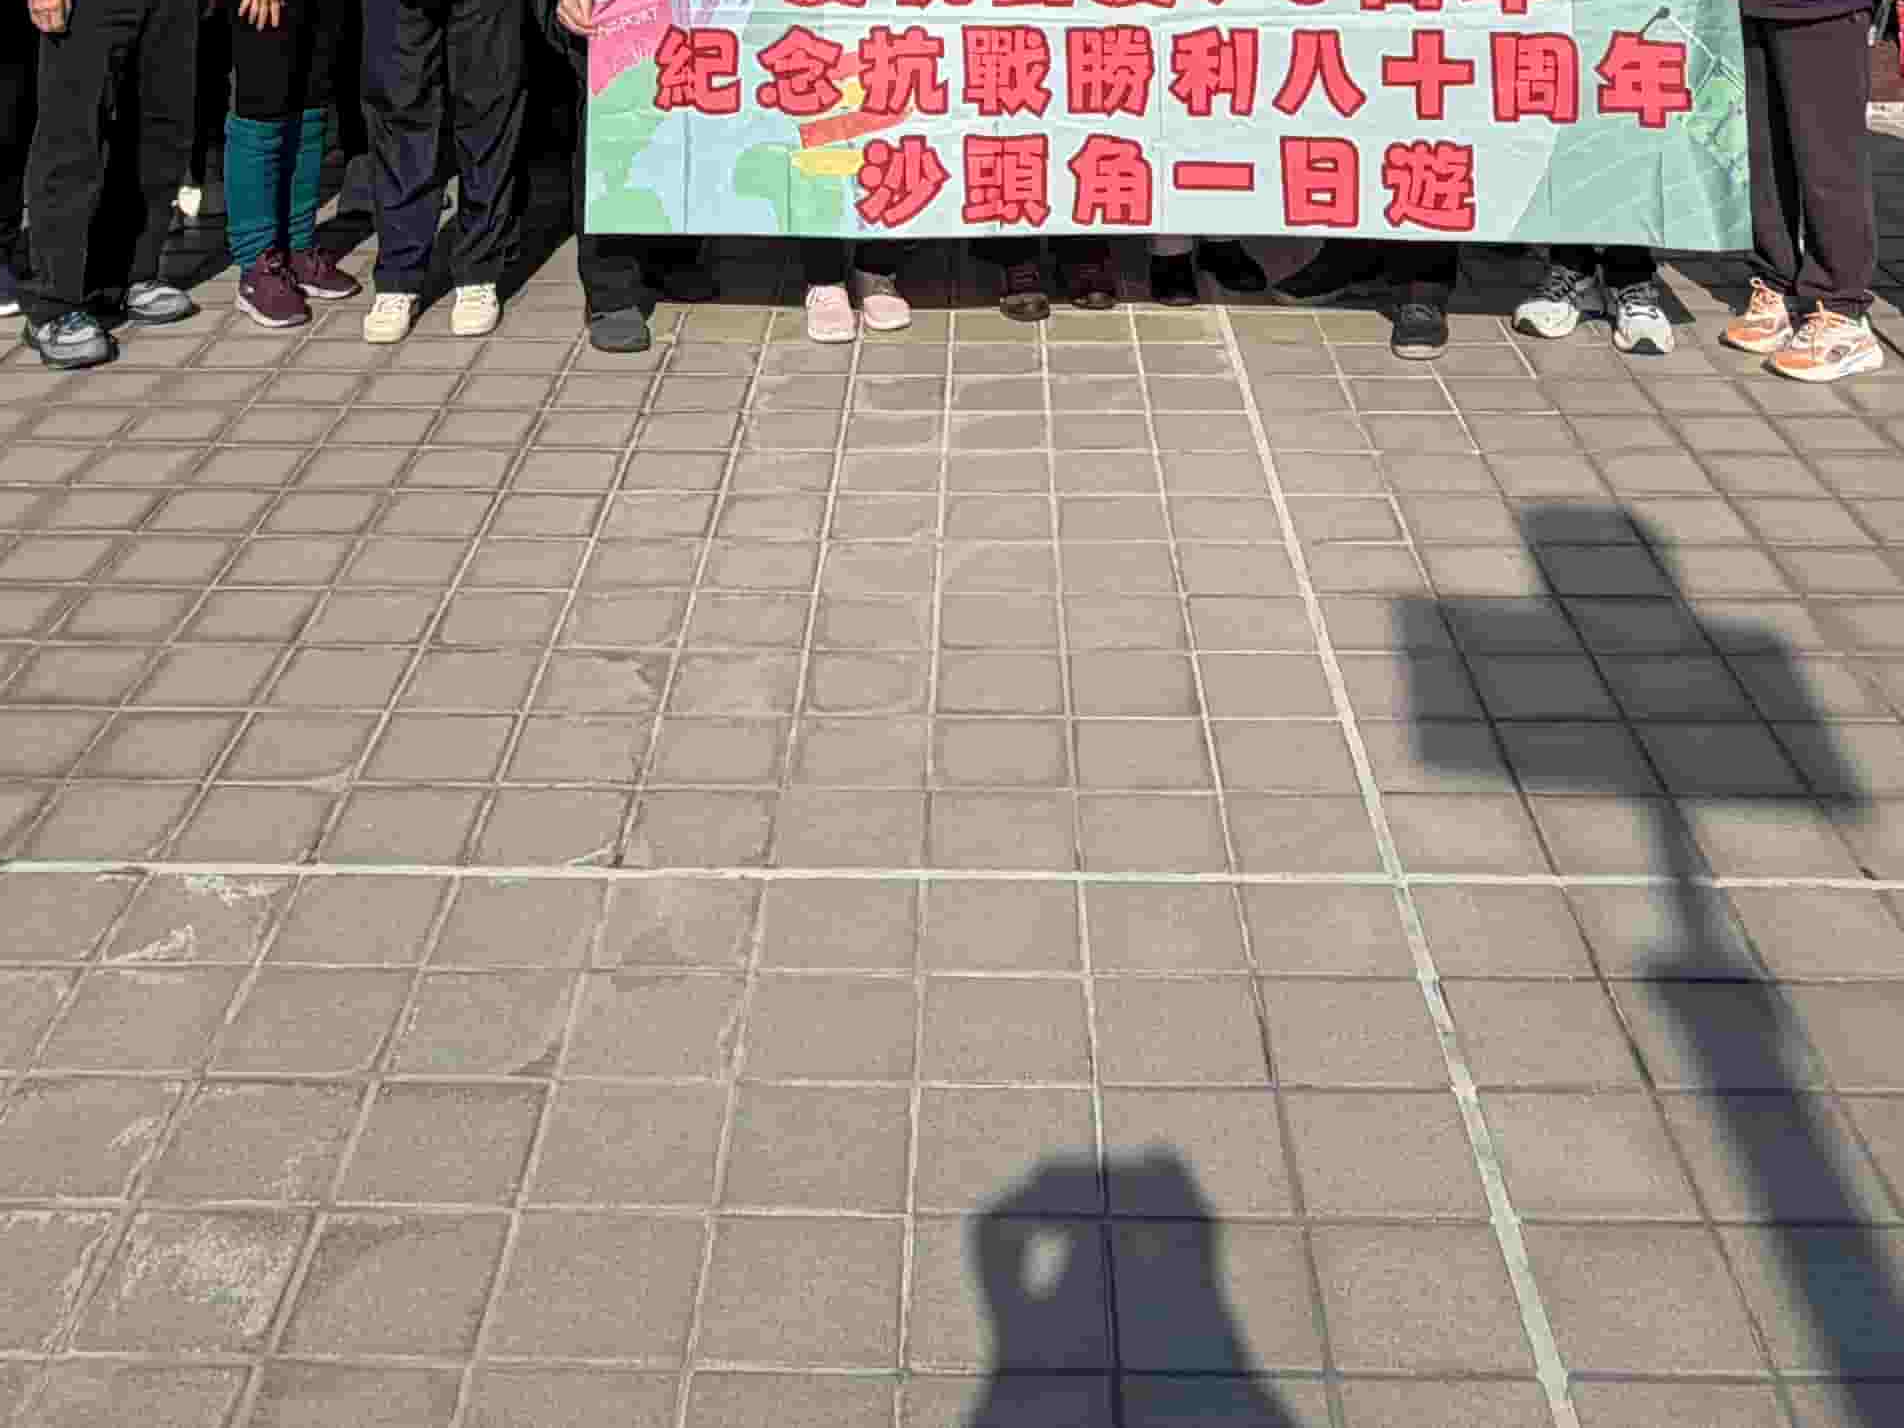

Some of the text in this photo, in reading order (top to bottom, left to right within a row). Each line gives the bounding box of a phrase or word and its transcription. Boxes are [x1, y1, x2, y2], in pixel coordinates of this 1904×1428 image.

[653, 24, 1694, 128] 紀念抗戰勝利八十周年
[855, 133, 1477, 232] 沙頭角一日遊
